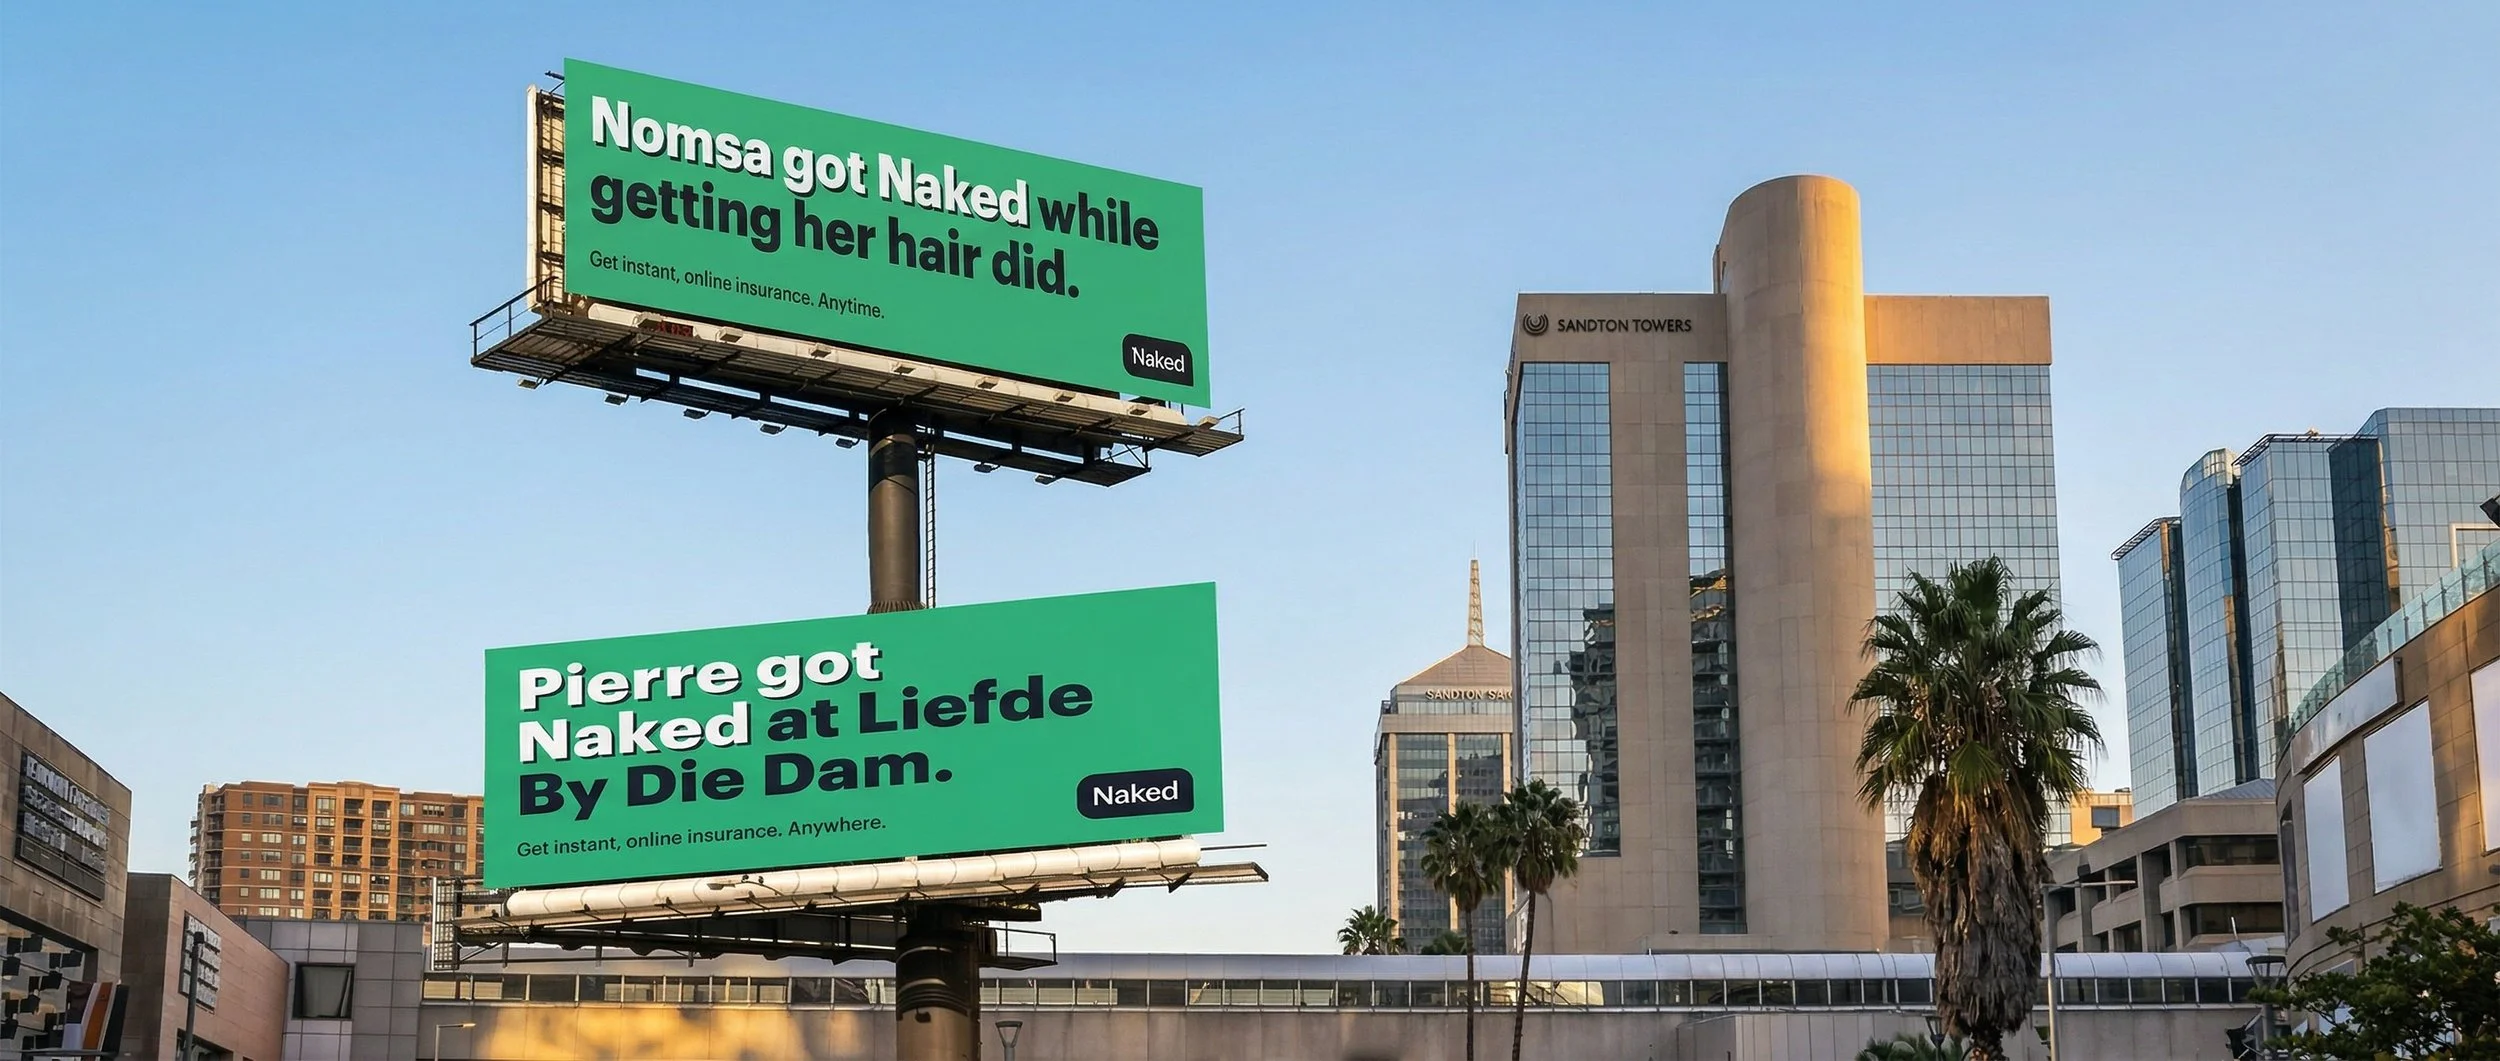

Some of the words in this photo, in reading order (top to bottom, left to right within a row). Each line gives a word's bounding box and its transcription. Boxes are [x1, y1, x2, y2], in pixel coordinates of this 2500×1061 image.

[591, 95, 773, 179] Nomsa
[783, 145, 868, 198] got
[878, 153, 1031, 230] Naked
[1037, 192, 1159, 250] while
[590, 175, 782, 254] getting
[794, 198, 877, 260] her
[888, 216, 983, 279] hair
[991, 240, 1080, 298] did.
[589, 250, 619, 270] Get
[622, 255, 681, 284] instant,
[683, 271, 733, 292] online
[735, 276, 815, 307] insurance.
[817, 292, 885, 319] Anytime.
[1131, 346, 1185, 373] Naked
[1557, 318, 1629, 333] SANDTON
[1632, 318, 1692, 333] TOWERS
[519, 659, 743, 712] Pierre
[756, 641, 883, 700] got
[1426, 688, 1484, 700] SANDTON
[518, 700, 751, 765] Naked
[767, 698, 840, 743] at
[859, 674, 1093, 734] Liefde
[518, 773, 608, 821] By
[626, 757, 745, 808] Die
[764, 751, 954, 797] Dam.
[1093, 780, 1179, 806] Naked
[518, 842, 549, 857] Get
[554, 835, 622, 855] instant,
[626, 832, 682, 849] online
[687, 824, 783, 845] insurance.
[788, 816, 887, 838] Anywhere.
